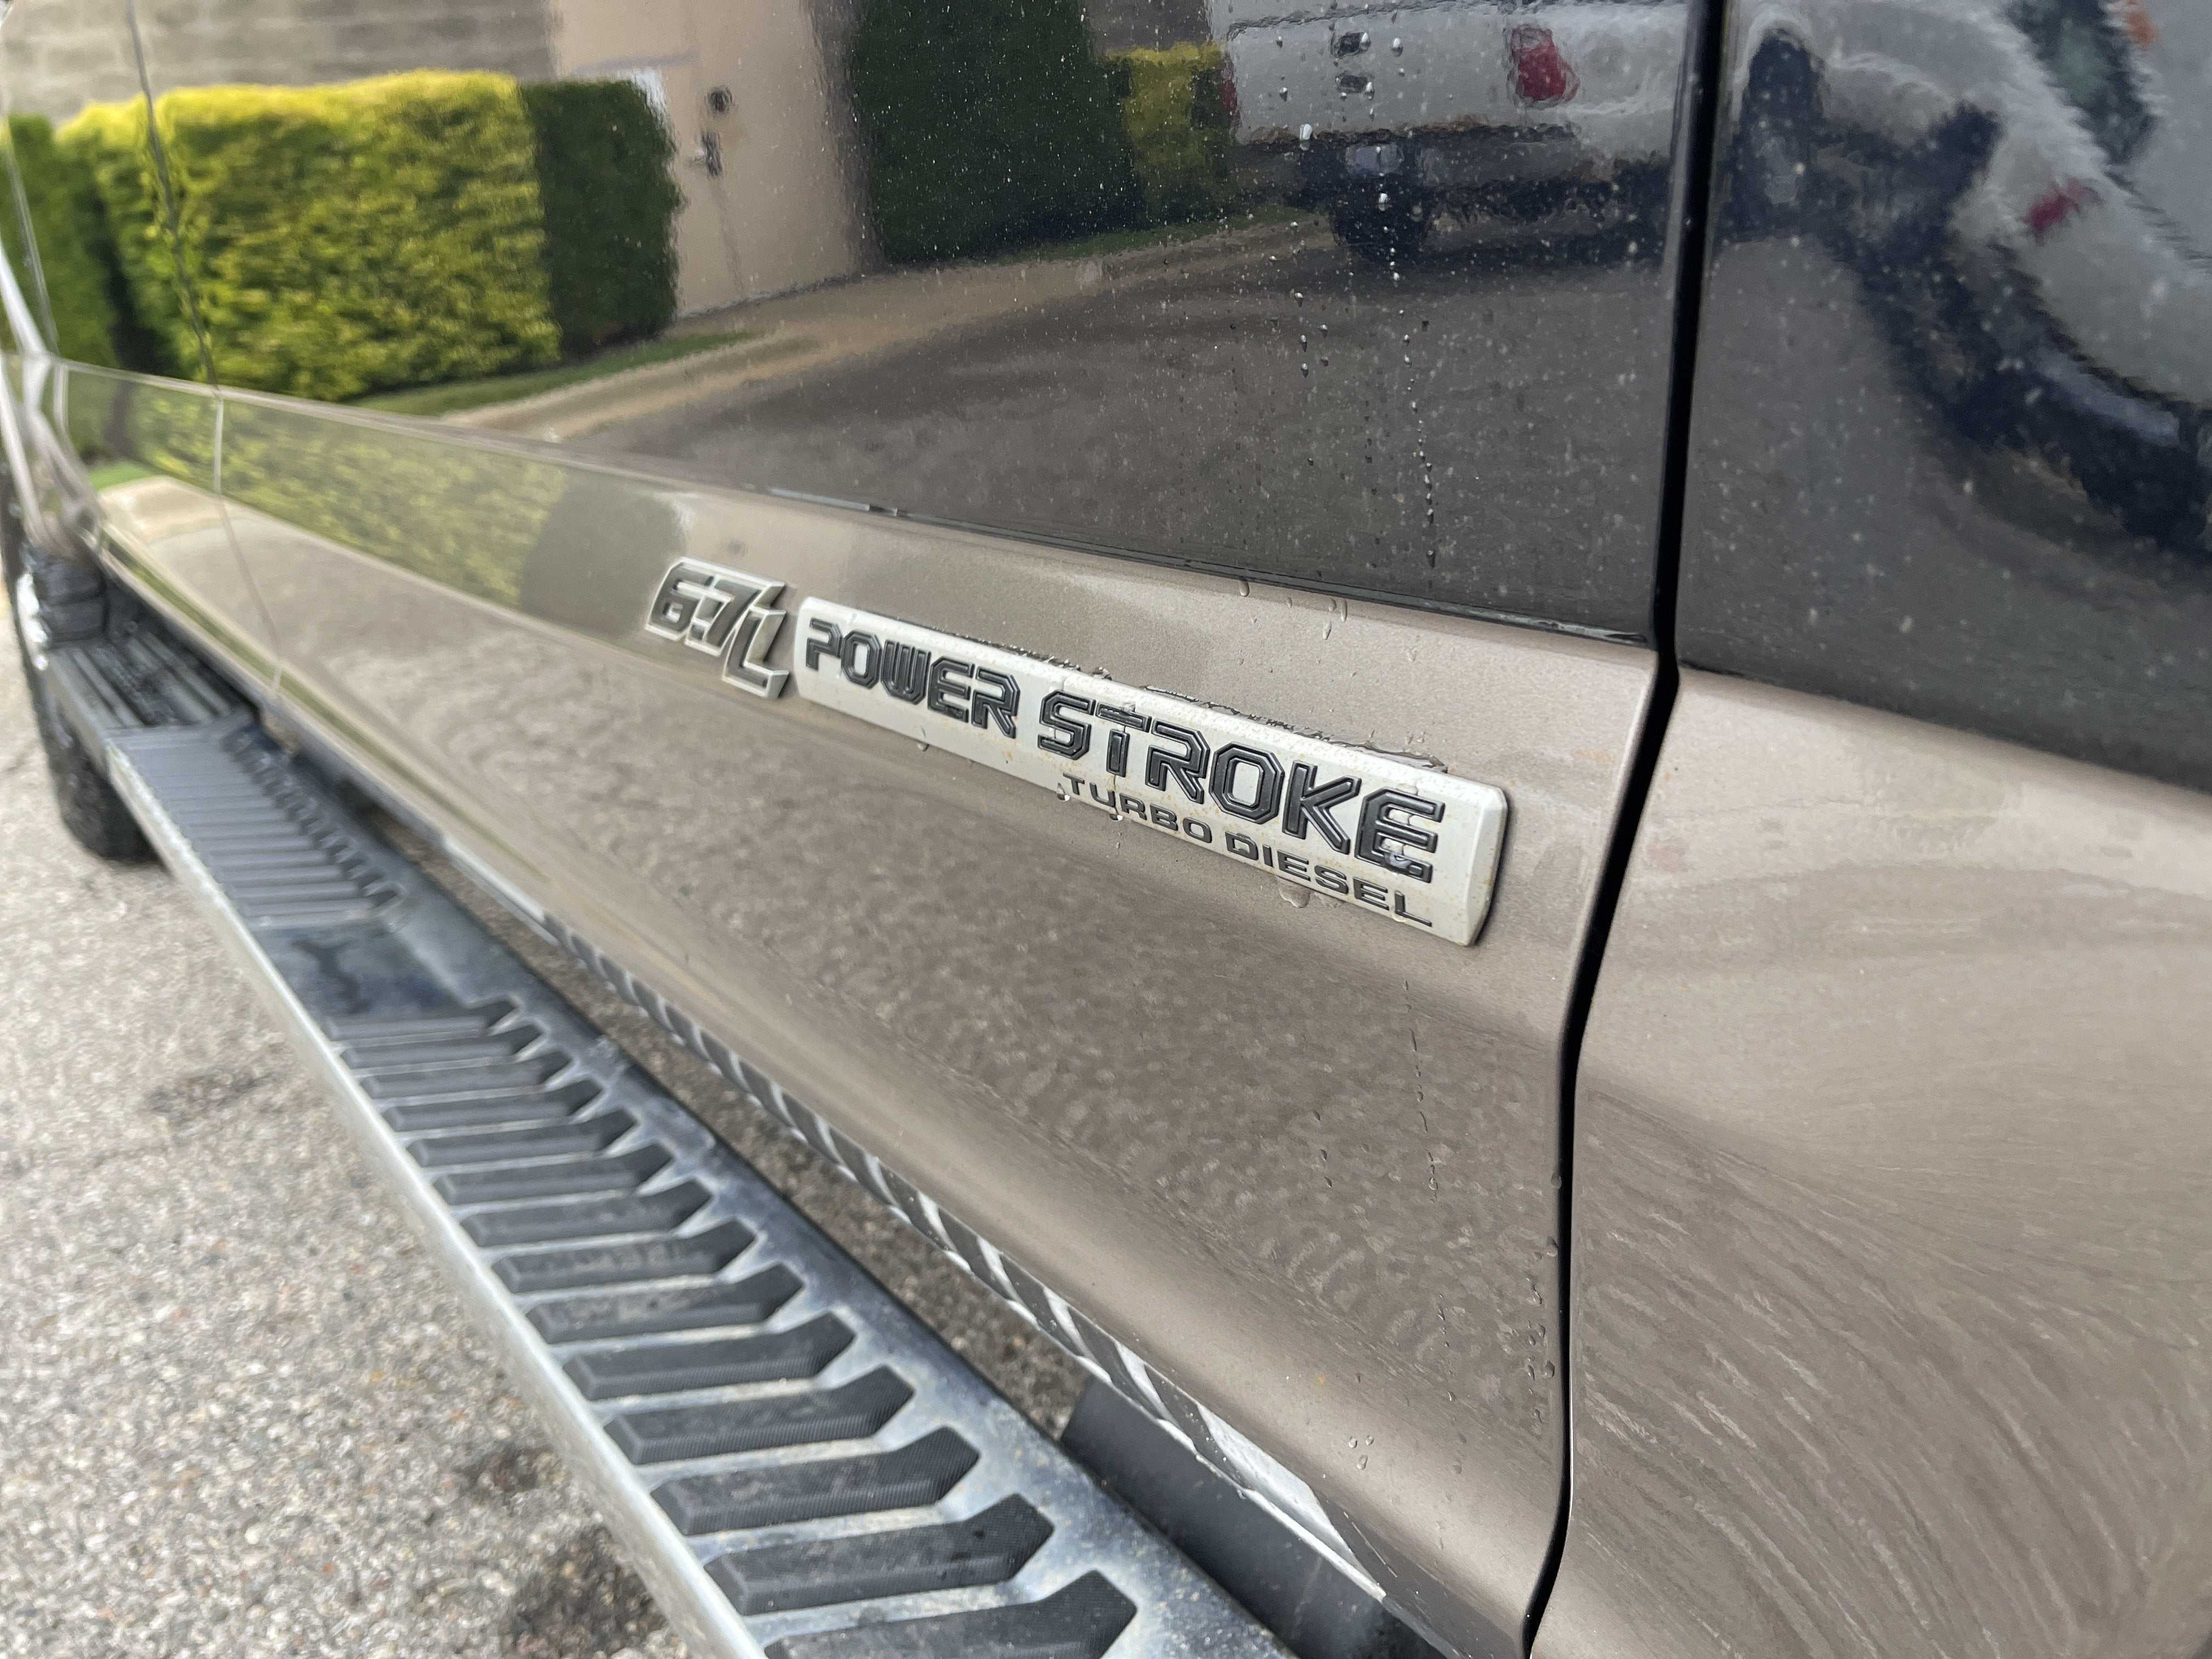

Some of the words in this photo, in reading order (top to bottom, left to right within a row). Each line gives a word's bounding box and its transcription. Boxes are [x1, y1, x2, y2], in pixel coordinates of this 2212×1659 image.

[805, 617, 1021, 739] POWER
[1037, 689, 1446, 883] STROKE
[1062, 772, 1213, 844] TURBO
[1224, 831, 1432, 928] DIESEL
